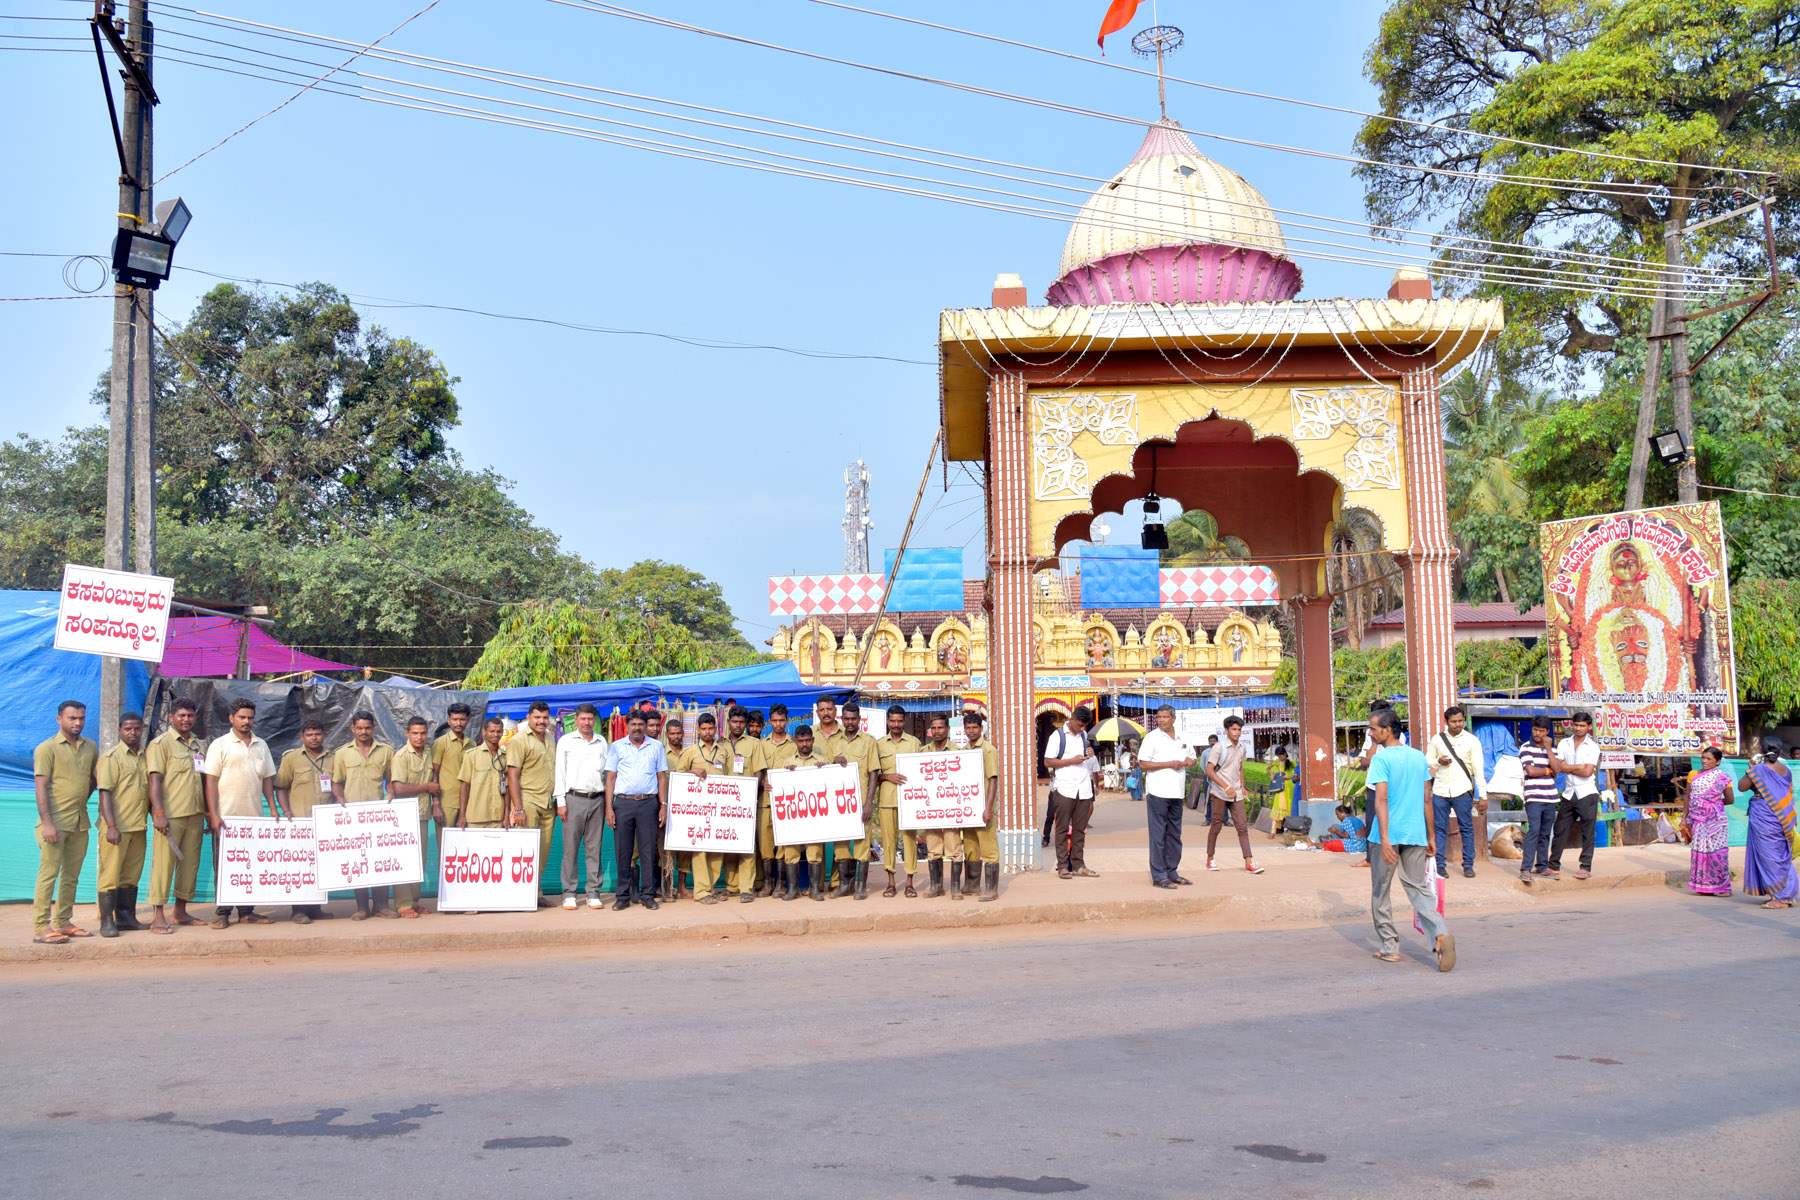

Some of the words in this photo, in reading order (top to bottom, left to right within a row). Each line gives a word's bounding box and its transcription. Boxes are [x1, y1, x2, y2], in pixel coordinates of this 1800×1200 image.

[1562, 518, 1630, 572] ಹೊಸಮಾರಿಗುಡಿ
[1680, 549, 1718, 584] ಕಾಪು
[67, 578, 166, 613] ಕಸವೆಂಬುವುದು
[1549, 574, 1576, 595] ಶ್ರೀ
[65, 612, 160, 650] ಸಂಪನ್ಮೂಲ.
[1607, 710, 1678, 736] ಸುಗ್ಗಿಮಾರಿಪೂಜೆ
[919, 756, 961, 782] ಸ್ವಚ್ಛತೆ
[707, 780, 741, 801] ಕಸವನ್ನು
[774, 782, 829, 820] ಕಸದಿಂದ
[835, 779, 858, 814] ರಸ
[904, 786, 931, 806] ನಮ್ಮ
[936, 782, 979, 804] ನಿಮ್ಮೆಲ್ಲರ
[334, 810, 352, 825] ಹಸಿ
[357, 807, 399, 827] ಕಸವನ್ನು
[915, 806, 976, 824] ಜವಾಬ್ದಾರಿ.
[258, 825, 271, 839] ಒಣ
[273, 824, 286, 839] ಕಸ
[687, 825, 711, 845] ಕೃಷಿಗೆ
[715, 826, 739, 840] ಬಳಸಿ.
[226, 846, 251, 869] ತಮ್ಮ
[340, 857, 369, 883] ಕೃಷಿಗೆ
[374, 855, 403, 873] ಬಳಸಿ.
[445, 846, 503, 883] ಕಸದಿಂದ
[511, 847, 534, 883] ರಸ
[230, 872, 253, 894] ಇಟ್ಟು
